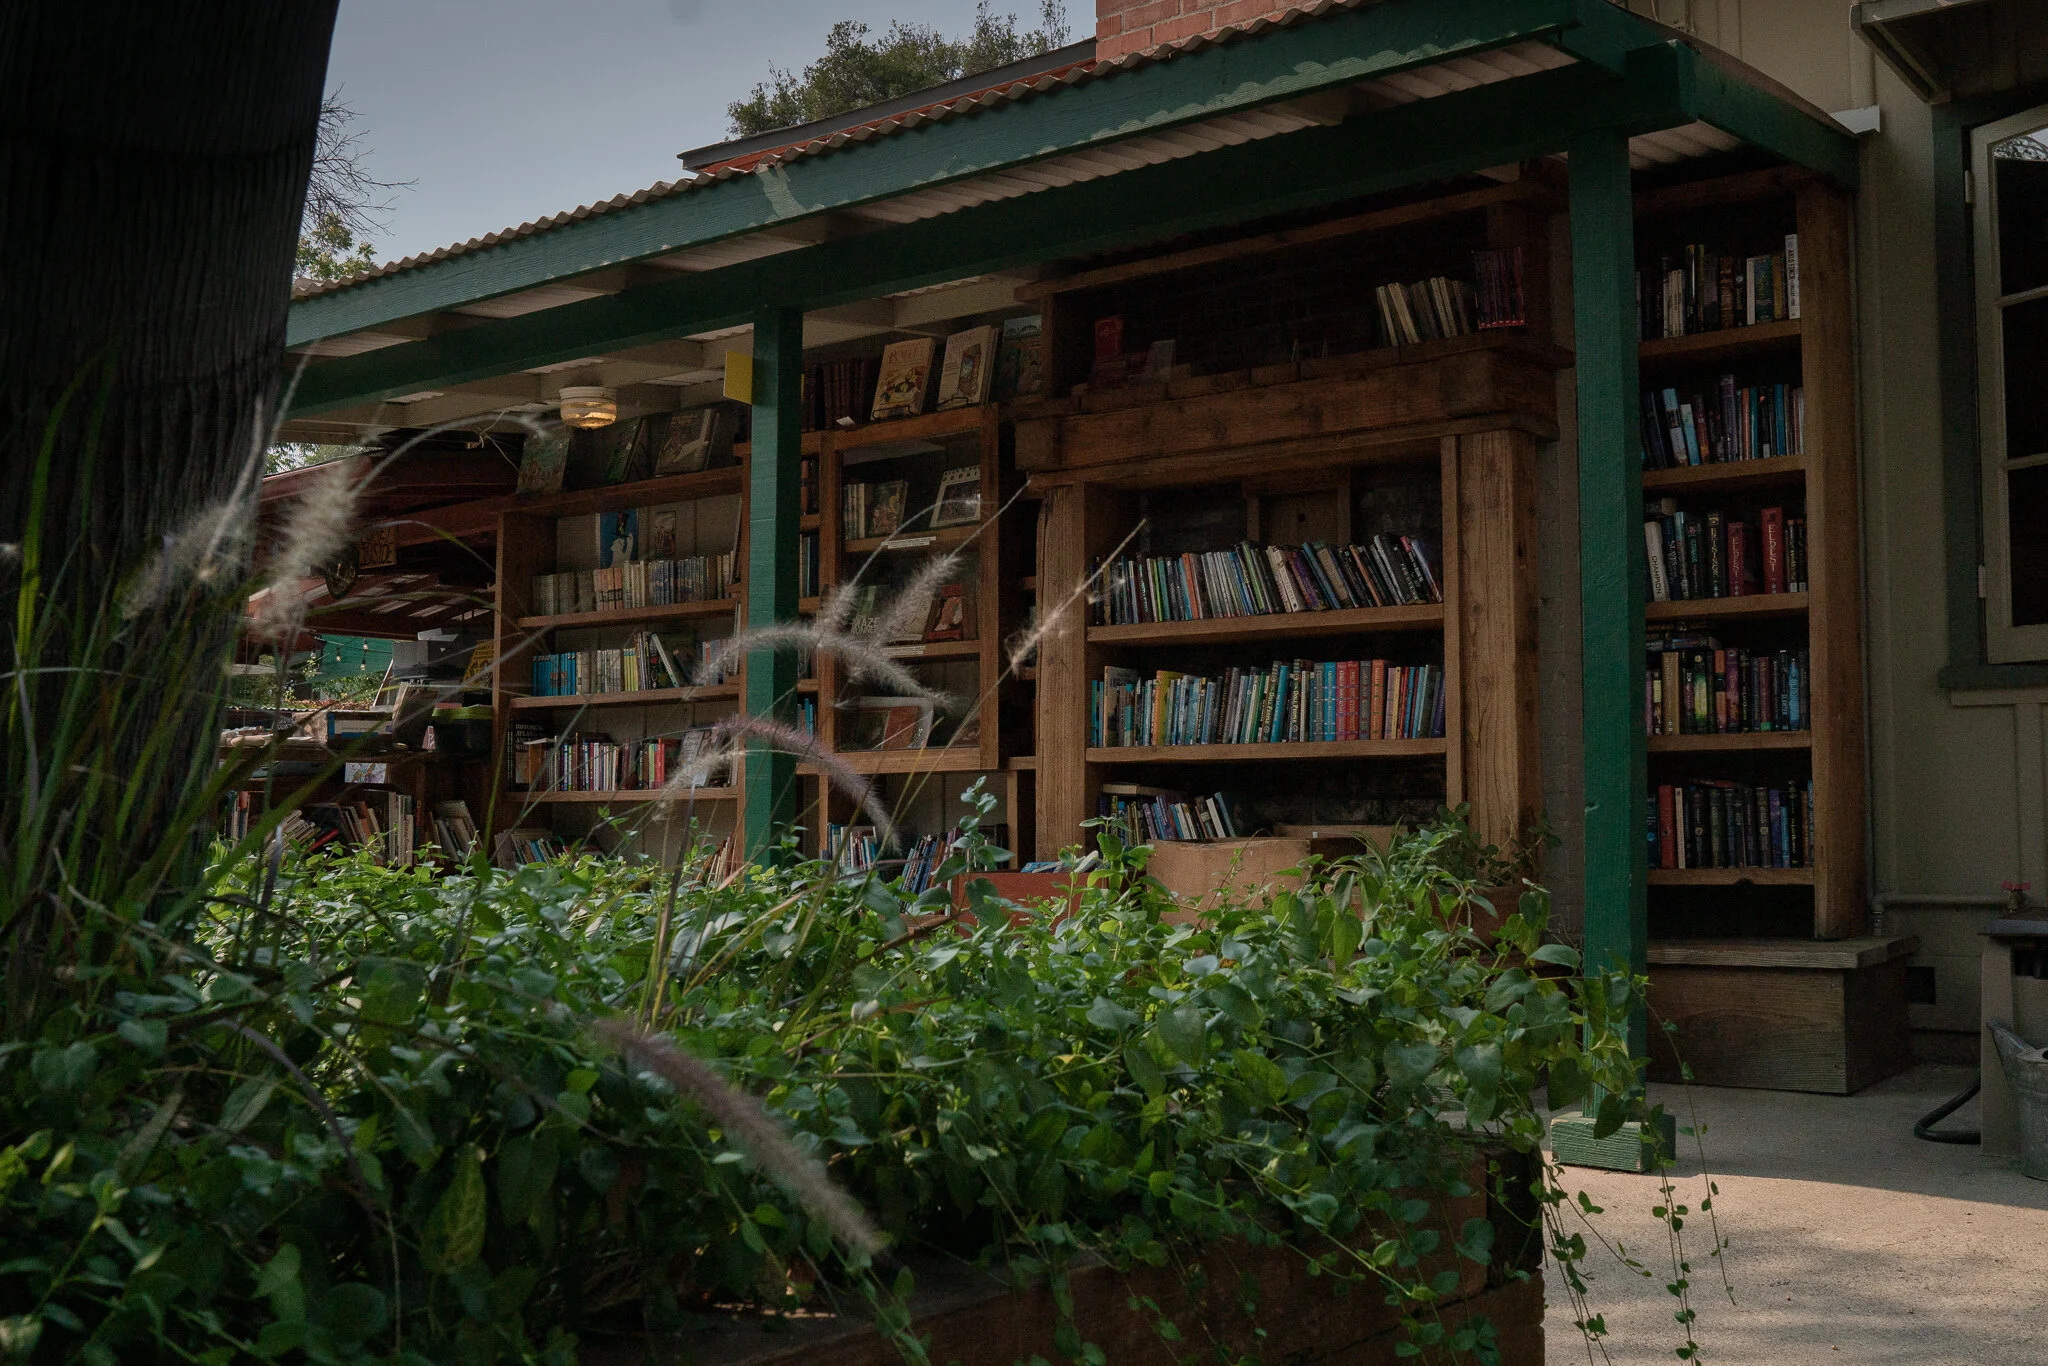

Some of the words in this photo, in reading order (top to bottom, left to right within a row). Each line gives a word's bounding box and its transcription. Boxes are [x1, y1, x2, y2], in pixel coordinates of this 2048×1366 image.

[1787, 249, 1796, 264] ARLO
[1788, 264, 1796, 281] FINCH
[1732, 536, 1740, 578] ELDEST
[1768, 524, 1778, 573] ELDEST
[1651, 555, 1663, 595] CHAMPION
[855, 617, 880, 628] MAZE
[1292, 690, 1300, 704] DOLL
